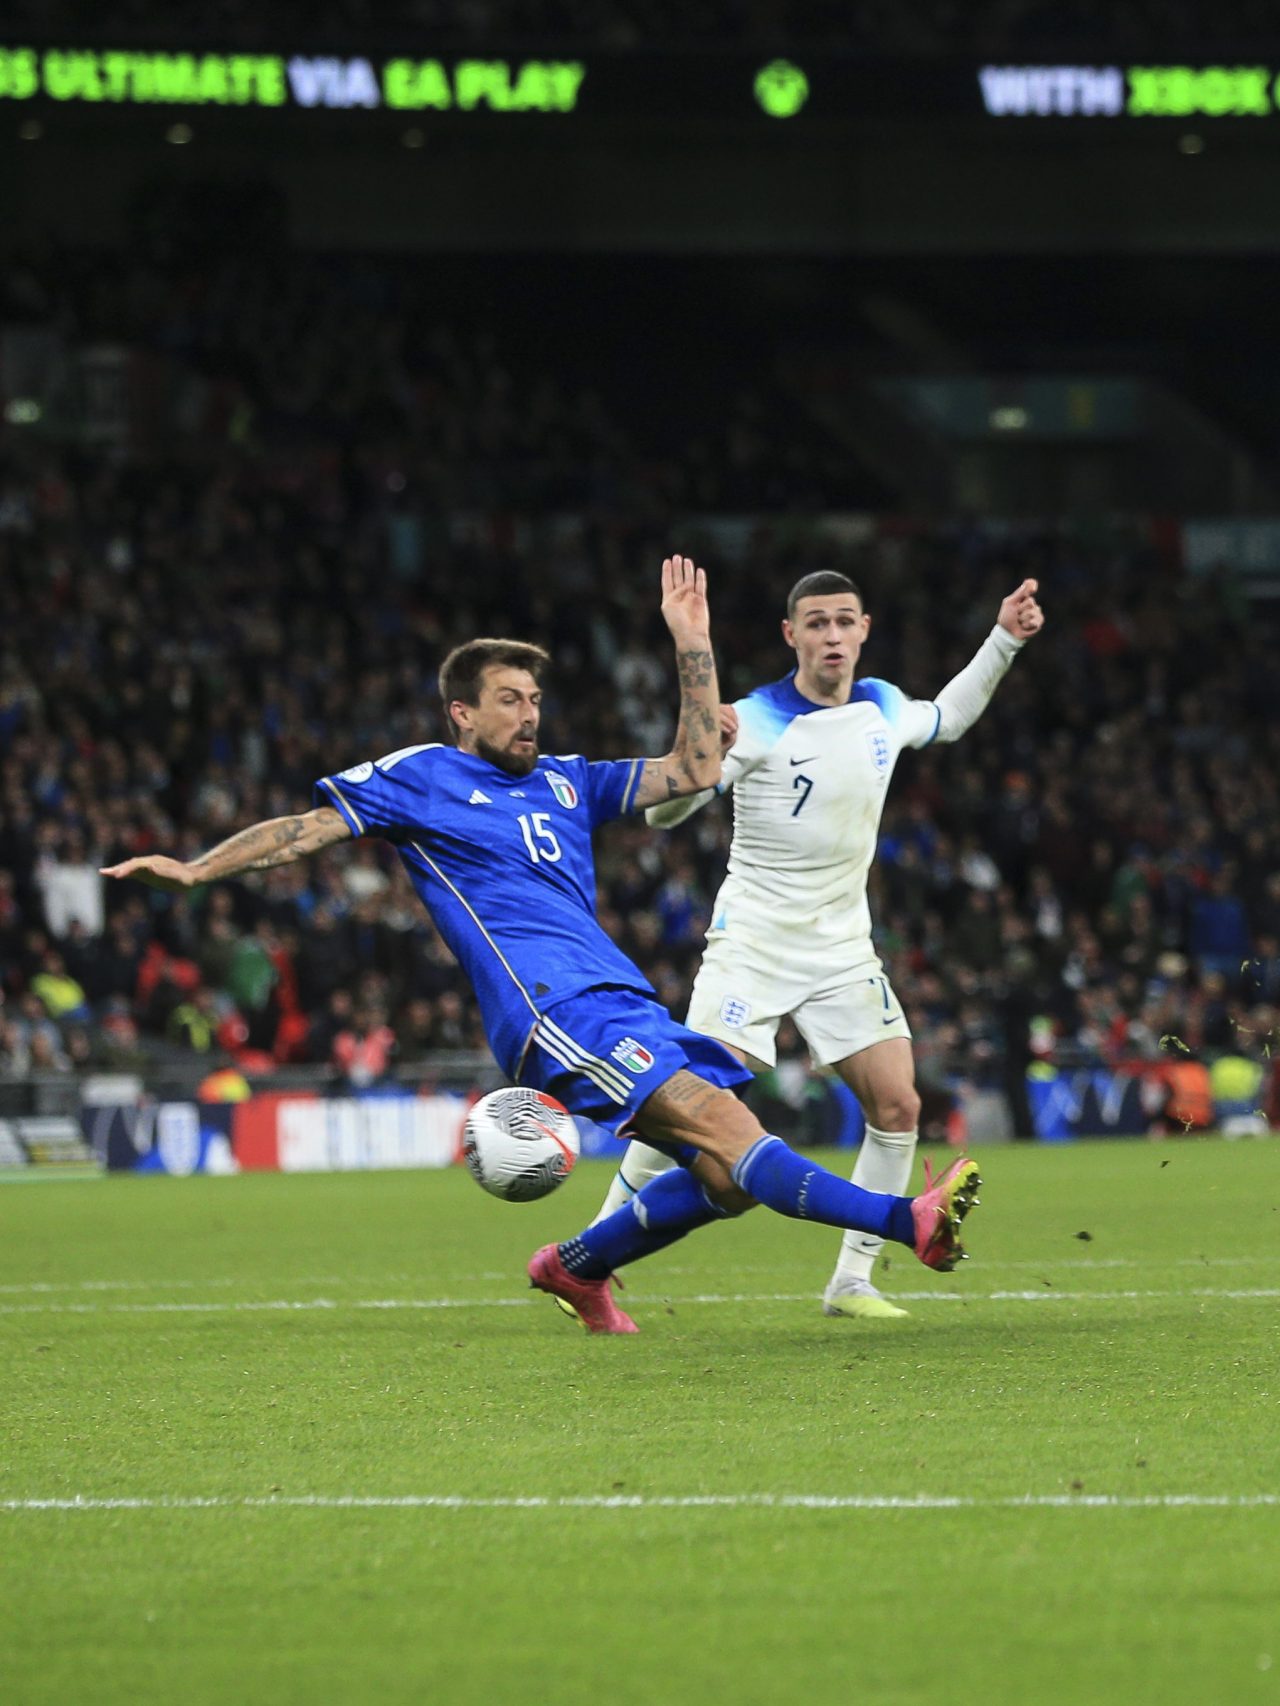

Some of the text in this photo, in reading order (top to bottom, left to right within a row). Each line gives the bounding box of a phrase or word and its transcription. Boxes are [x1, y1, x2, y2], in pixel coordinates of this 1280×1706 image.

[43, 52, 285, 105] ULTIMATE
[287, 57, 380, 107] VIA
[383, 59, 451, 108] EA
[455, 61, 584, 110] PLAY
[979, 66, 1123, 115] WITH
[1127, 66, 1270, 115] XBOX
[792, 774, 814, 817] 7
[517, 812, 562, 863] 15
